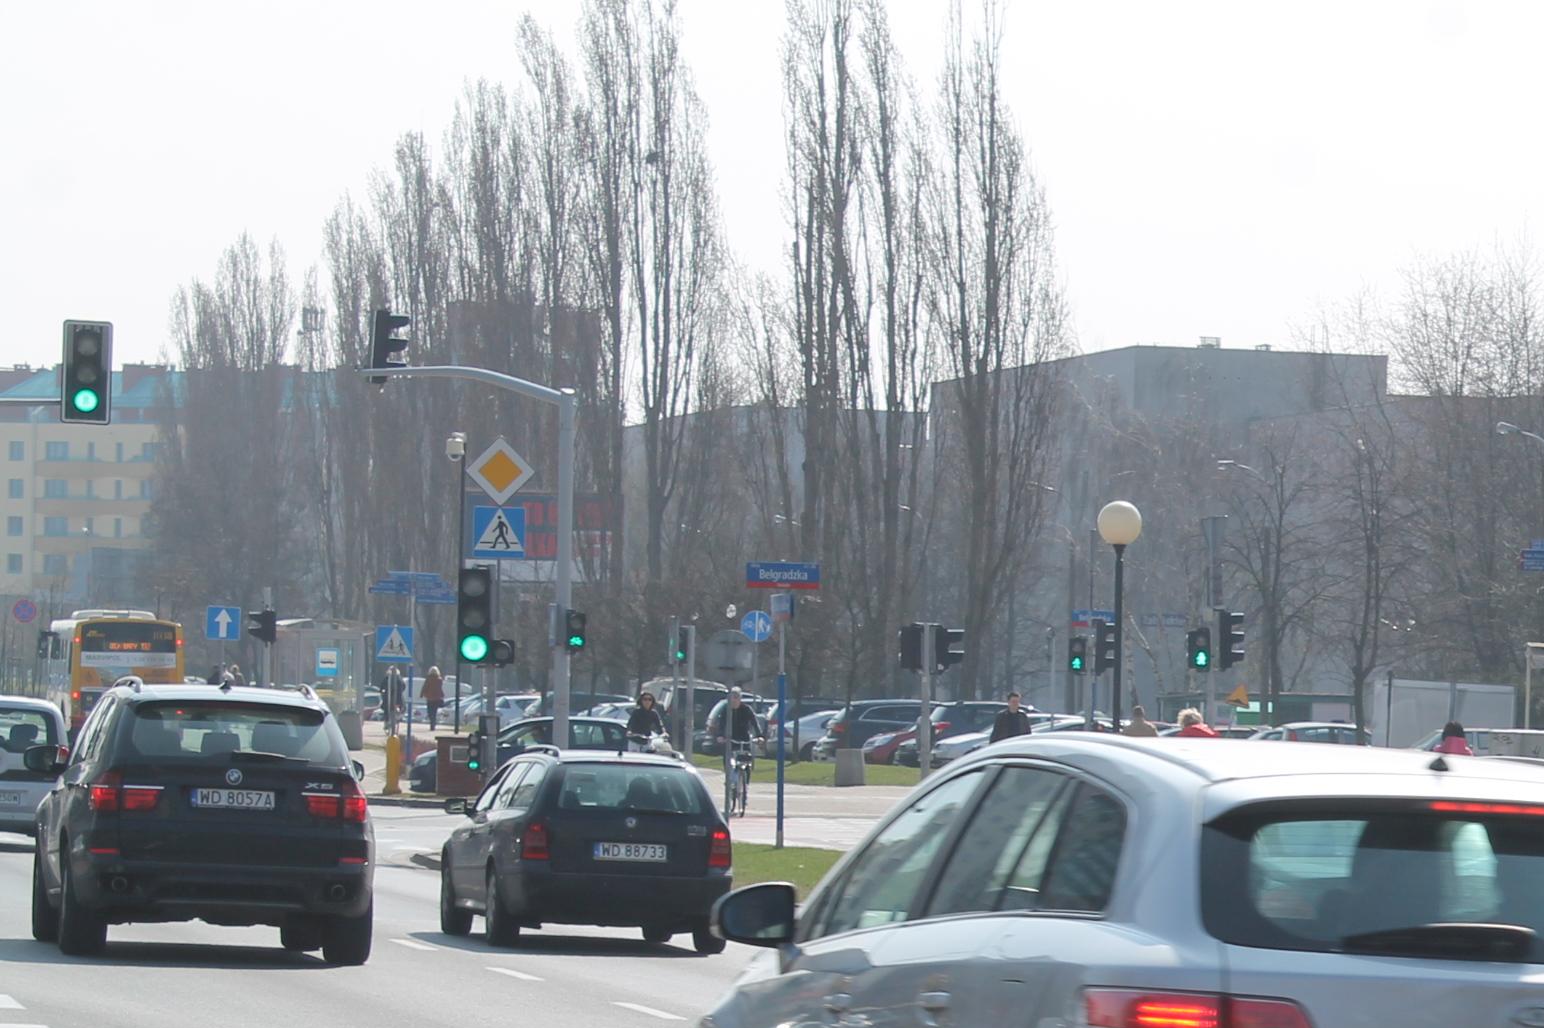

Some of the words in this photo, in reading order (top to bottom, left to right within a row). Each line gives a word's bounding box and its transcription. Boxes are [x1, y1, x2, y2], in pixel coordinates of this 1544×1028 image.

[759, 568, 808, 583] Belgradzka
[304, 782, 334, 790] X5
[200, 790, 222, 805] WD
[227, 791, 273, 807] 8057A
[602, 843, 621, 857] WD
[624, 845, 666, 859] 88733
